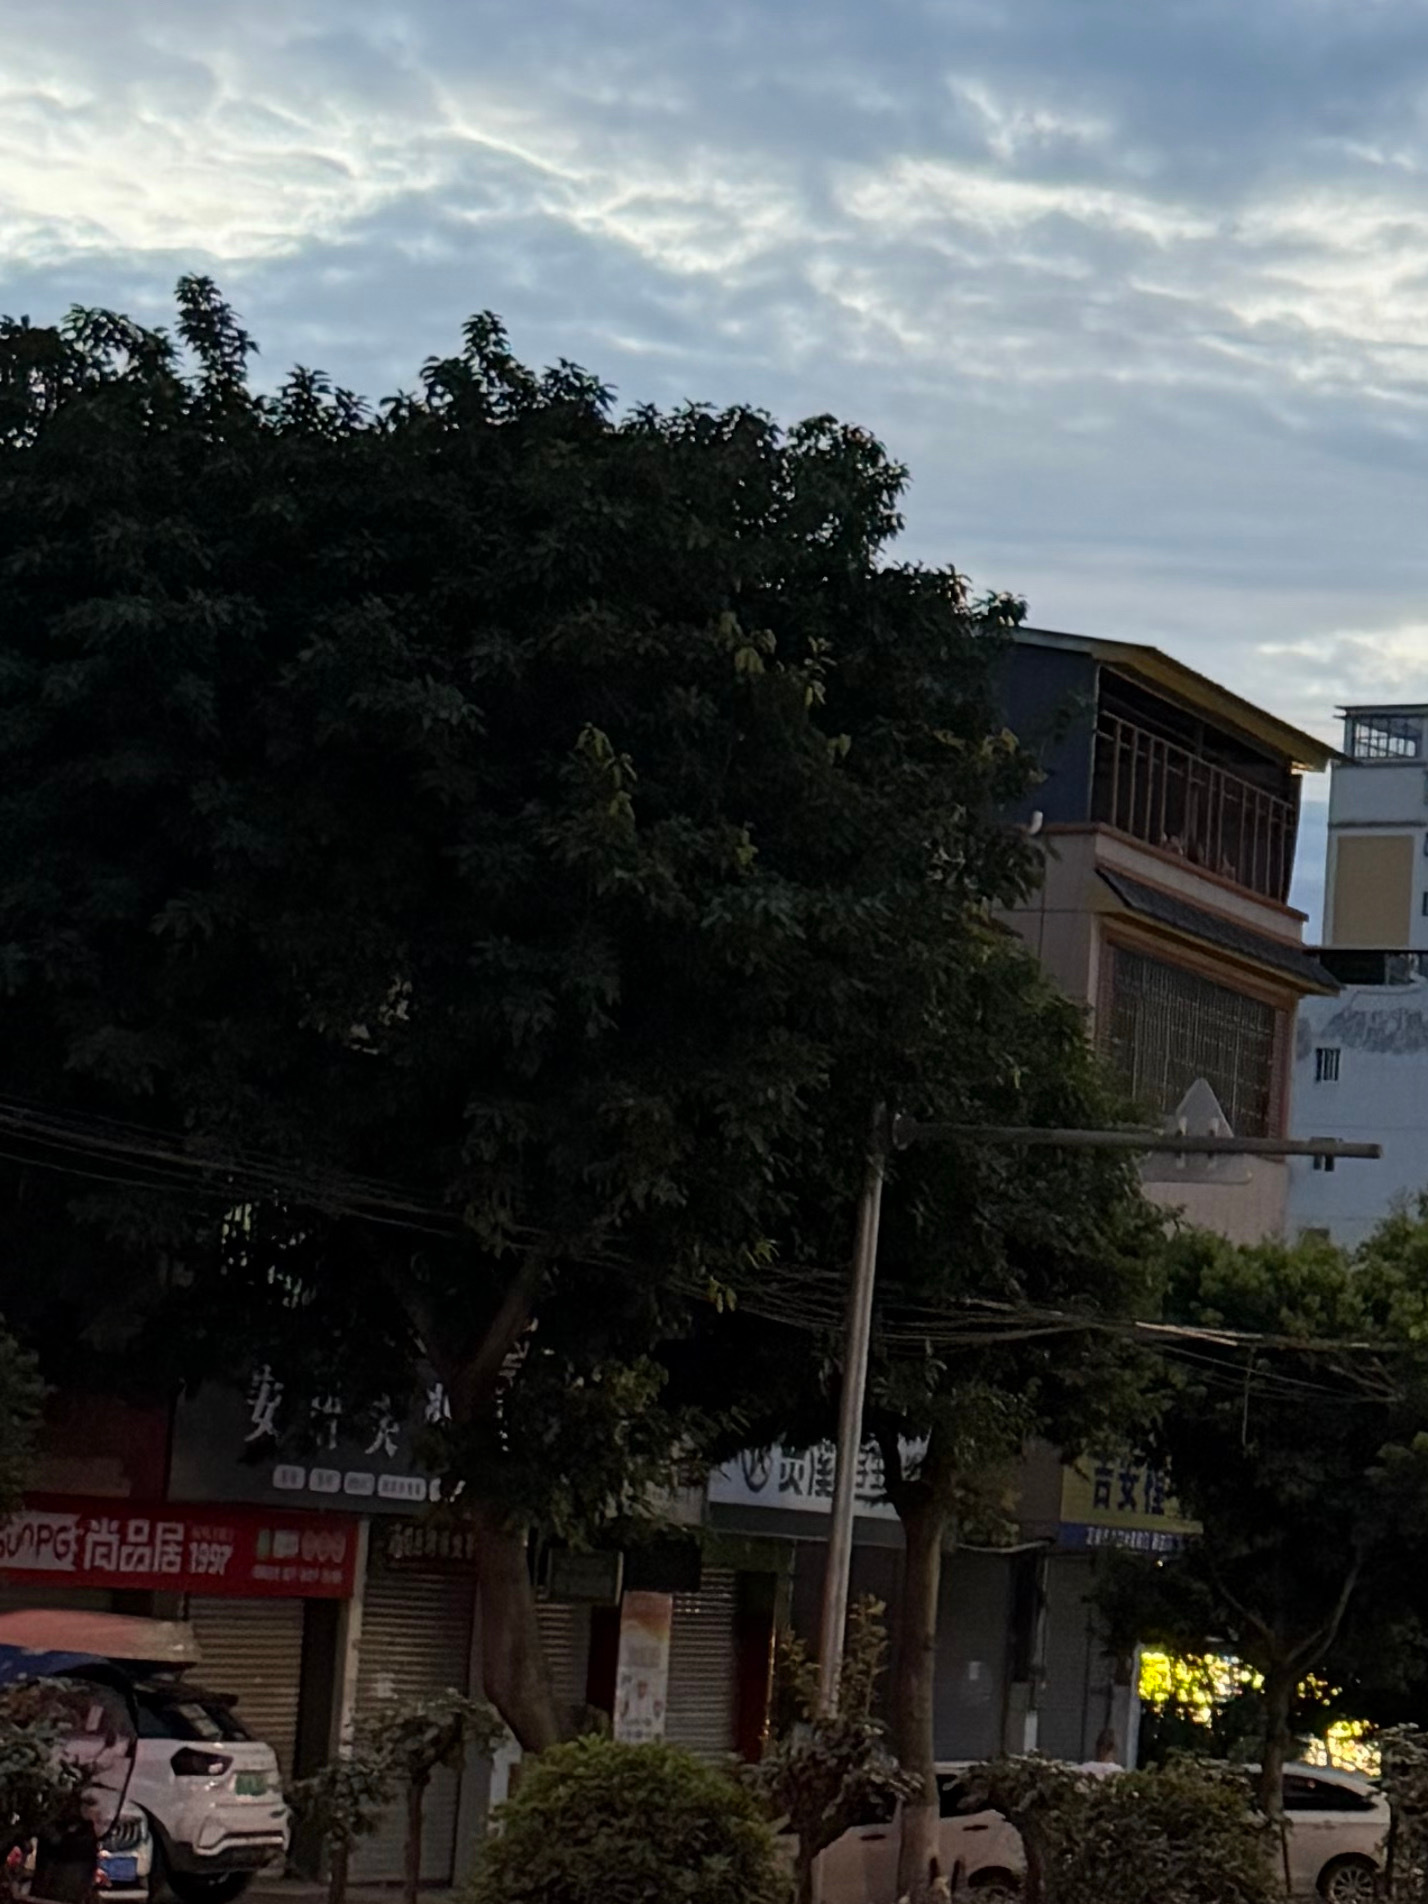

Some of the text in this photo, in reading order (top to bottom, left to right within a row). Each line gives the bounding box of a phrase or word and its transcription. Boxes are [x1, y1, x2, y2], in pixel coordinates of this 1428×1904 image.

[83, 1516, 185, 1574] 尚品居
[188, 1542, 234, 1576] 1997
